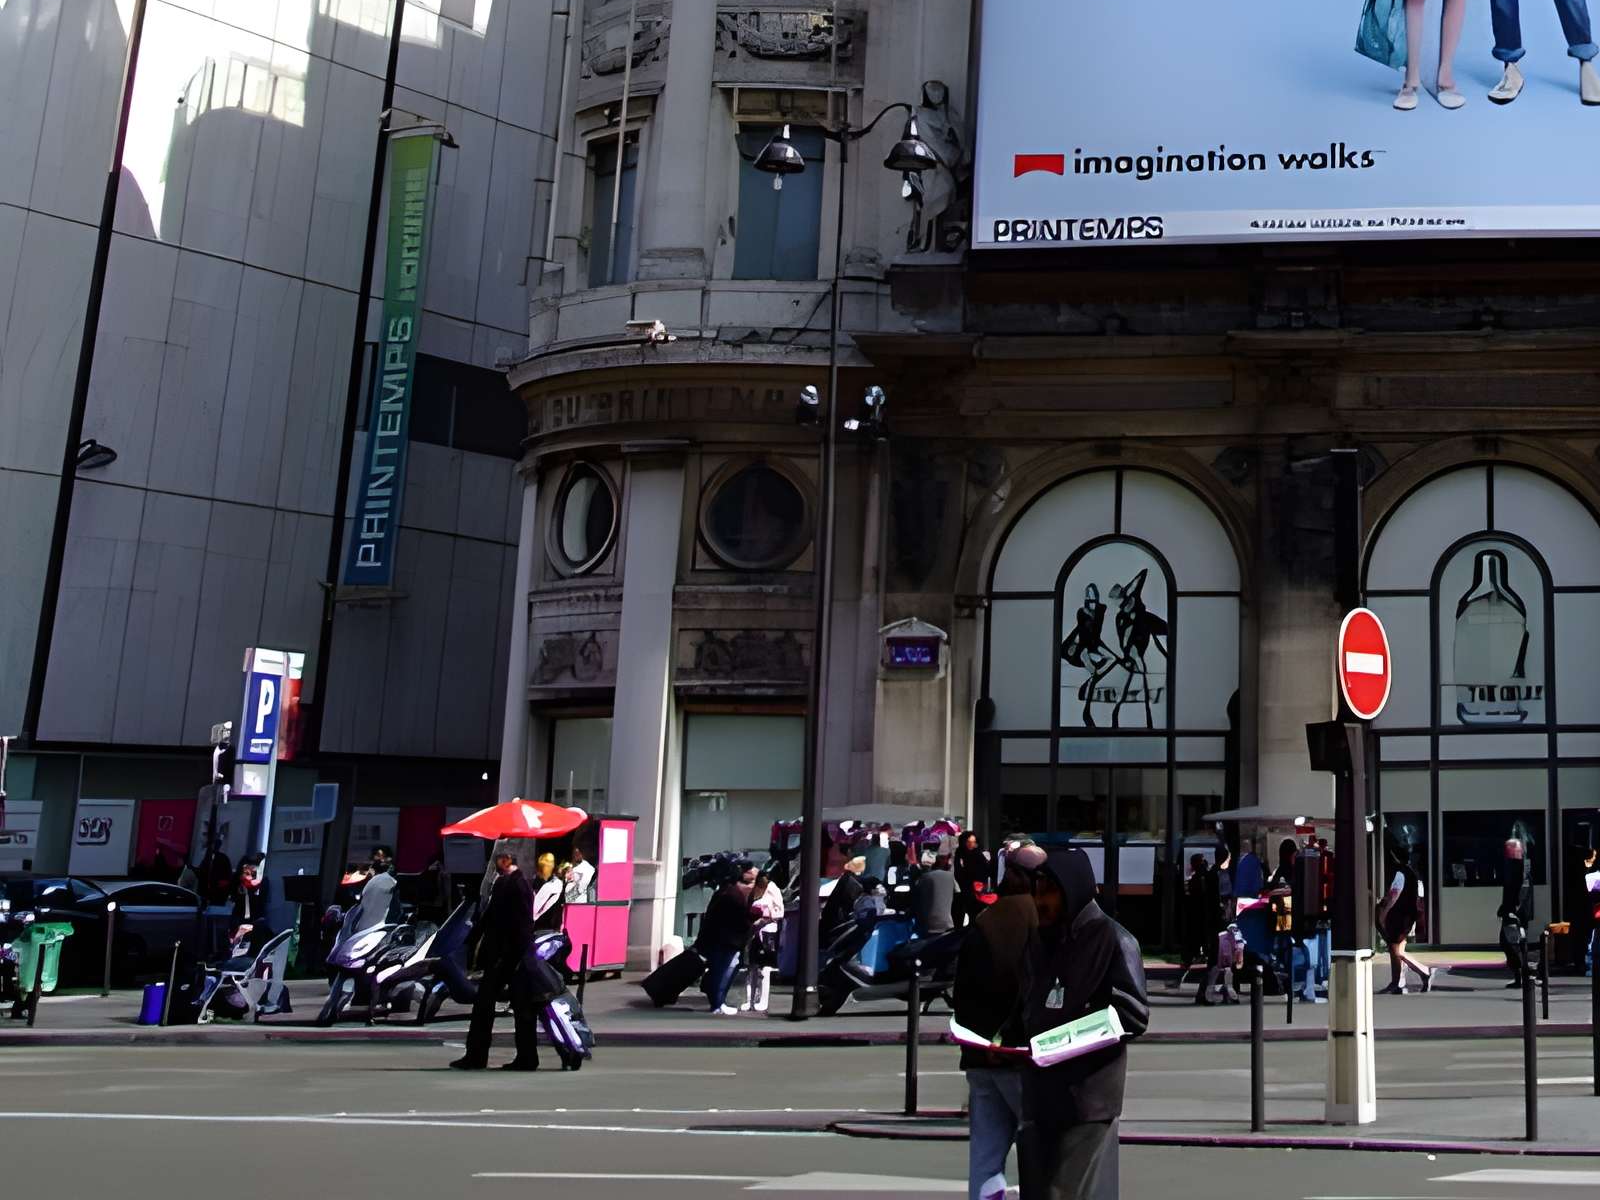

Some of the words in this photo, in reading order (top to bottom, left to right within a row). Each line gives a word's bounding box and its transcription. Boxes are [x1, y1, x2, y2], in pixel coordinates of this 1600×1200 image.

[1074, 144, 1267, 181] imagination
[1278, 142, 1376, 170] walks
[993, 215, 1164, 242] PRINTEMPS
[255, 678, 276, 735] P
